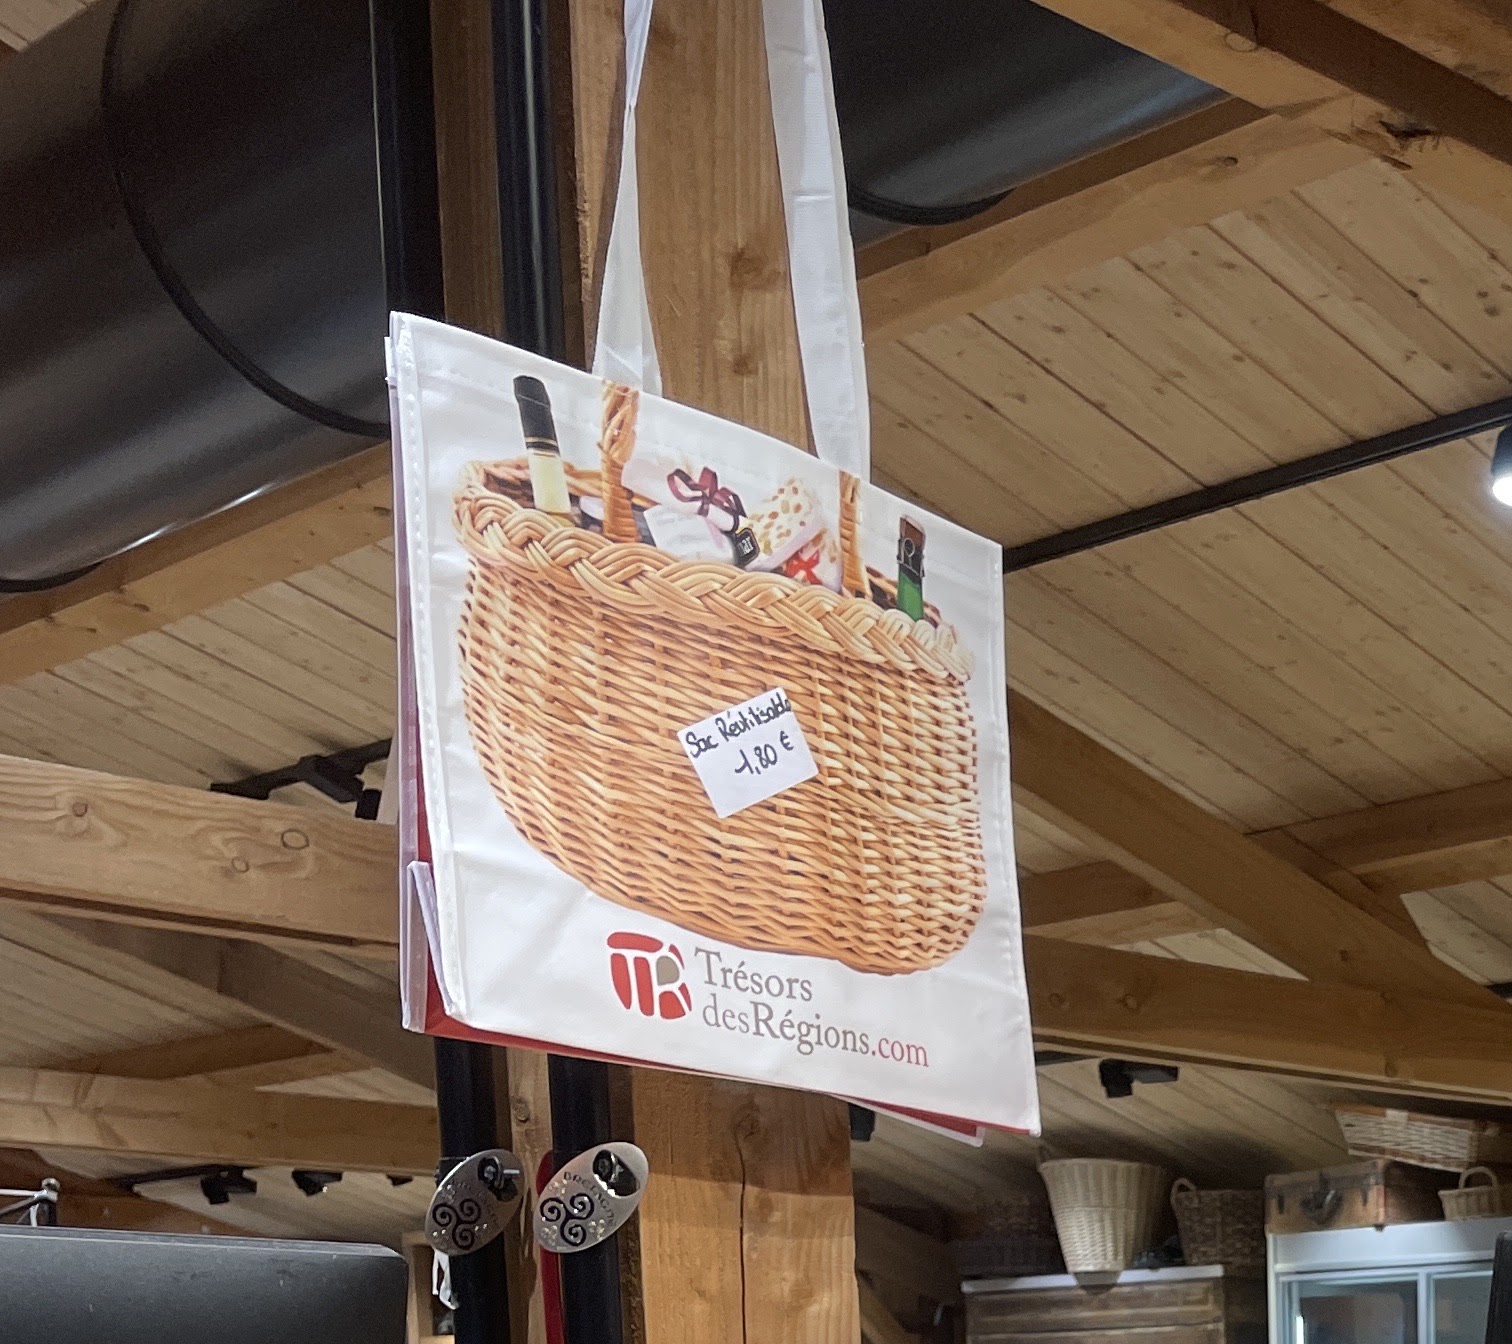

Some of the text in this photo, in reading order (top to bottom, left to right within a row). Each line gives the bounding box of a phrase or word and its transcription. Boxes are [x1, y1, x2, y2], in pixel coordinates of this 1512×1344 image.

[686, 731, 719, 758] Sac
[734, 743, 777, 775] 1,80
[694, 947, 813, 1001] Trésors
[702, 993, 929, 1067] desRégions.com
